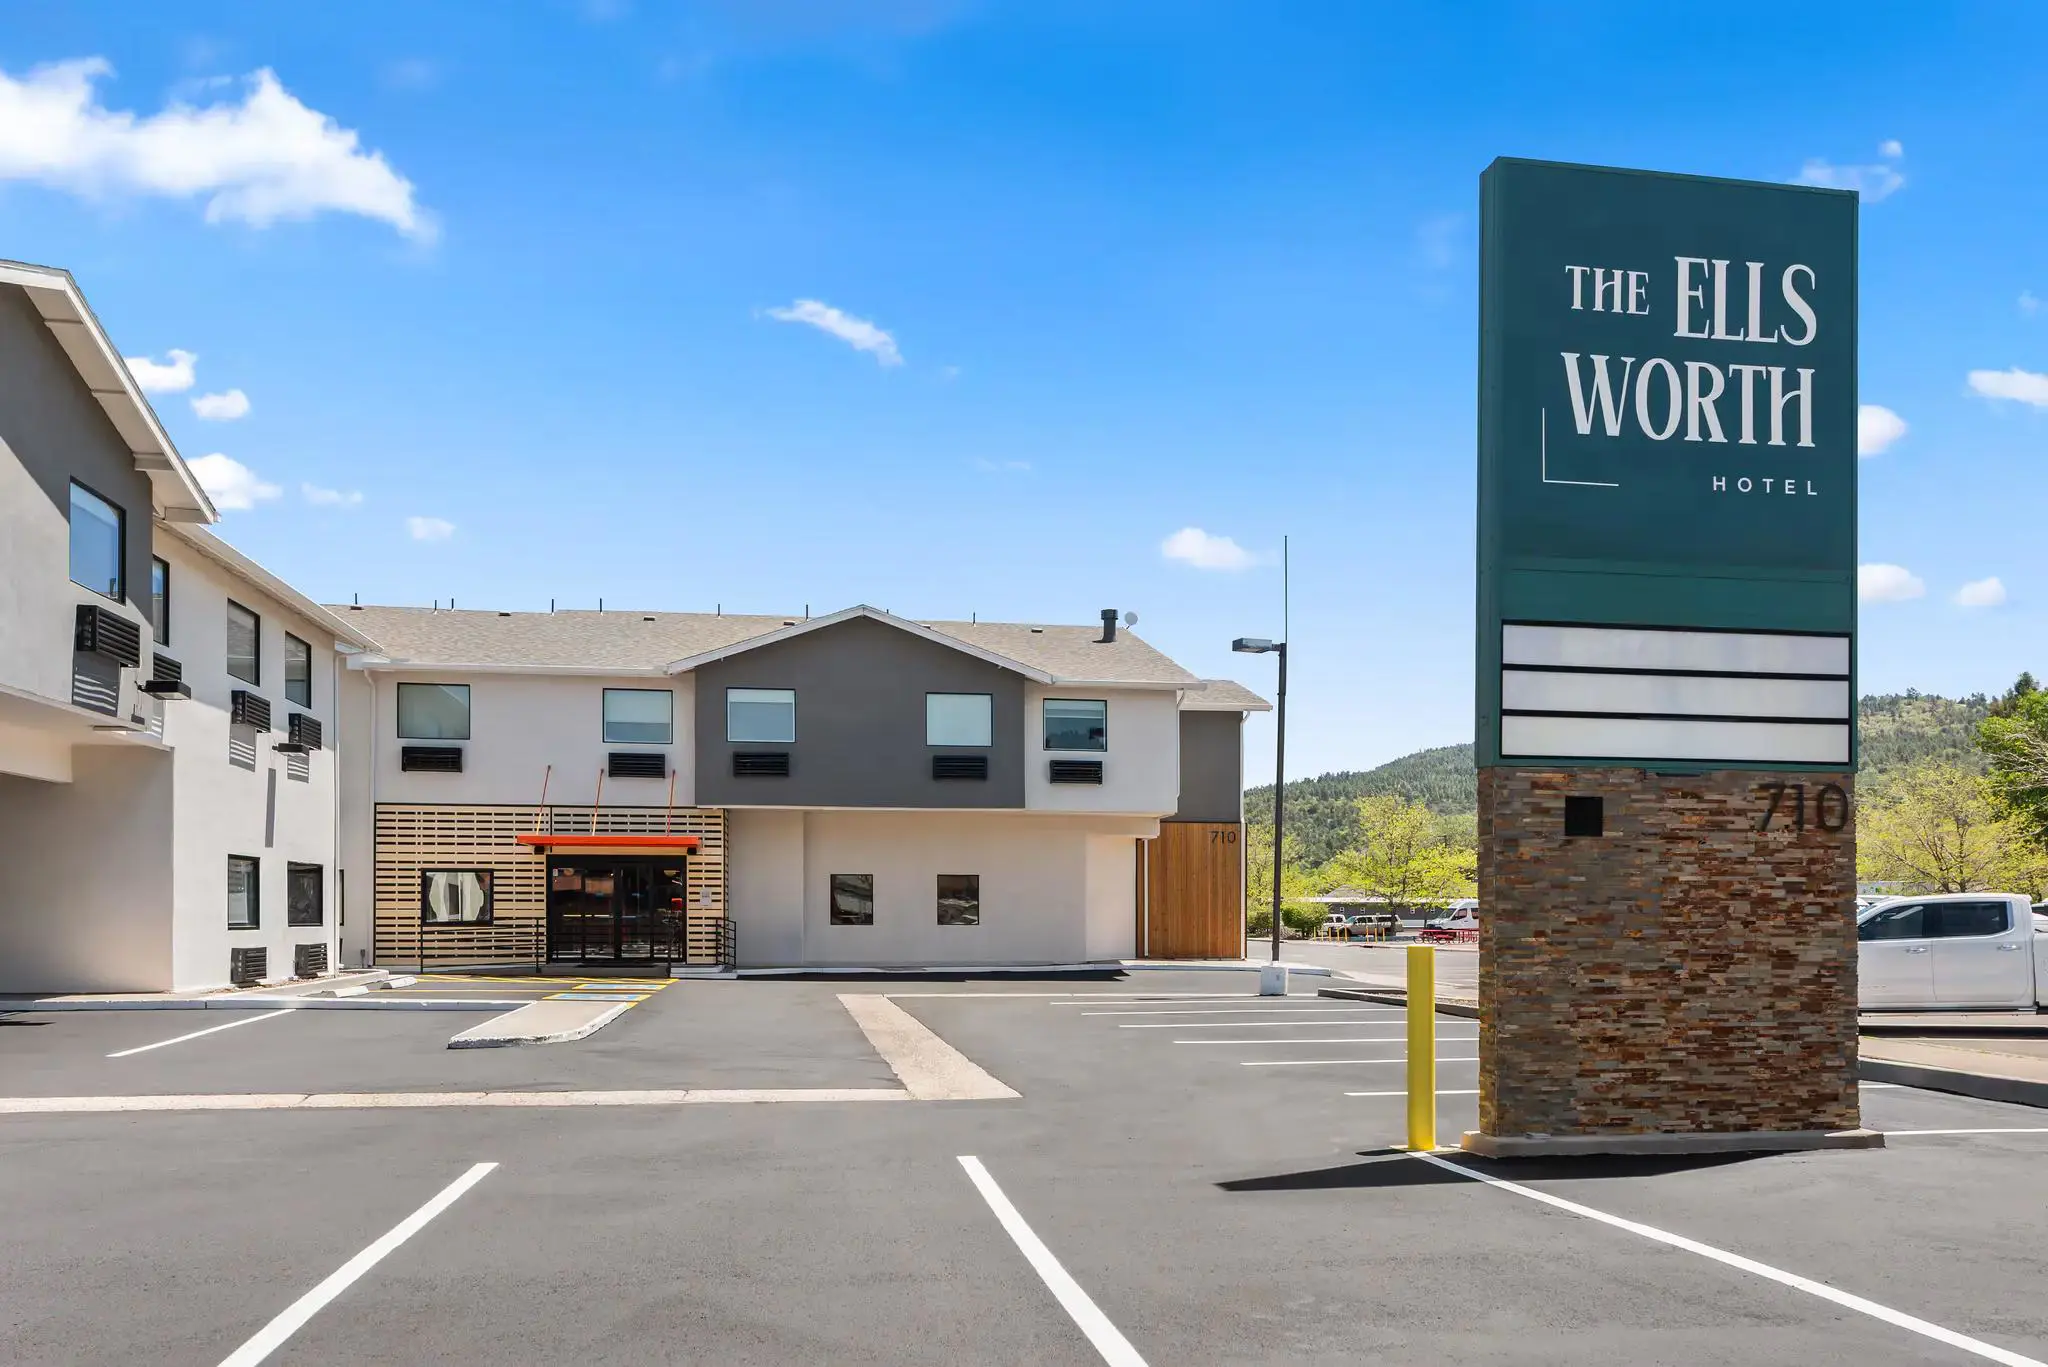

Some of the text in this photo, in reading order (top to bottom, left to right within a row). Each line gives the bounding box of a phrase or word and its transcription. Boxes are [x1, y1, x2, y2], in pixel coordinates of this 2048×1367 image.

[1565, 255, 1818, 346] THE ELLS
[1560, 351, 1816, 448] WORTH
[1712, 475, 1818, 496] HOTEL
[1757, 783, 1849, 833] 710
[1210, 830, 1236, 844] 710
